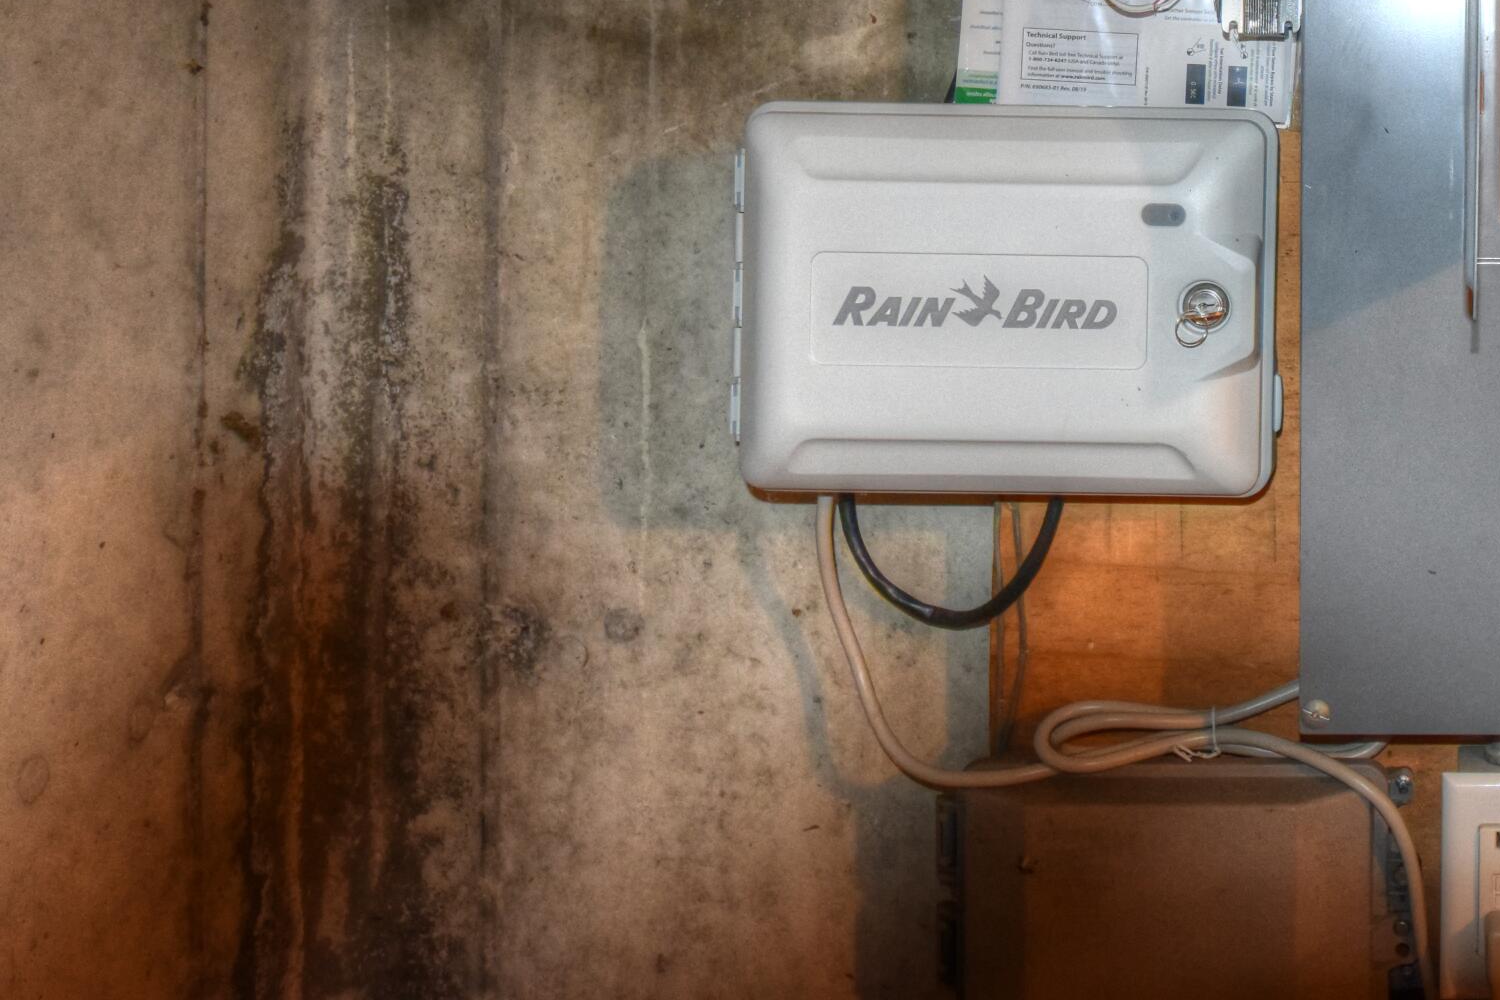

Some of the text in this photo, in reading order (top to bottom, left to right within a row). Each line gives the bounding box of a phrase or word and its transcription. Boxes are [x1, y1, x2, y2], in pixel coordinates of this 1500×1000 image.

[1026, 31, 1087, 41] Technical Support
[832, 286, 1119, 331] RAIN BIRD
